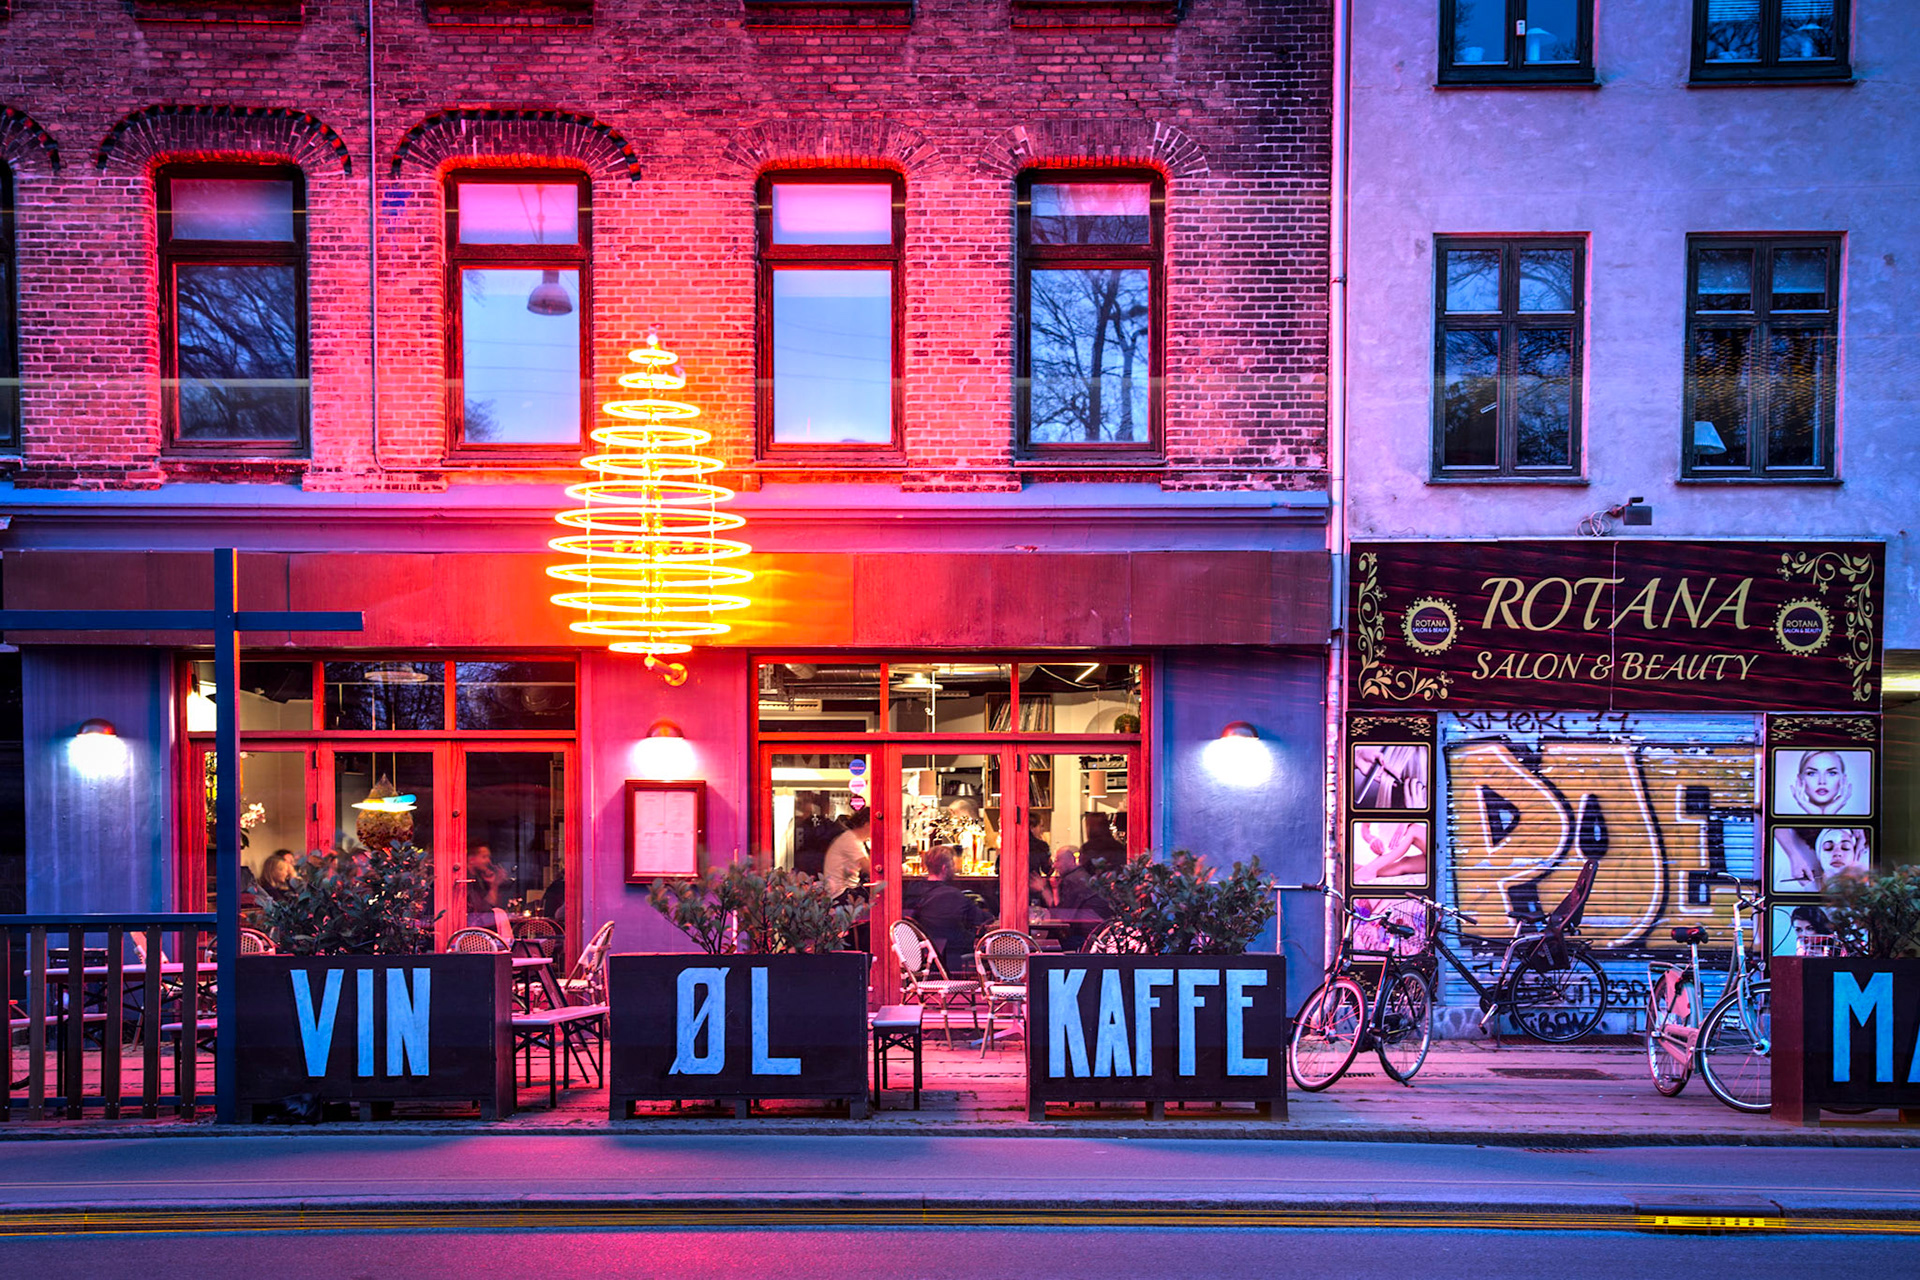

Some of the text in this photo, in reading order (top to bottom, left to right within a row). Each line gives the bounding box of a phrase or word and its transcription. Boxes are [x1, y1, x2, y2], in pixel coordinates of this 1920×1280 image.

[1415, 620, 1447, 628] ROTANA
[1481, 577, 1753, 632] ROTANA
[1786, 620, 1819, 628] ROTANA
[1472, 651, 1760, 681] SALON & BEAUTY
[289, 967, 431, 1077] VIN
[668, 966, 802, 1076] ØL
[1047, 967, 1270, 1079] KAFFE
